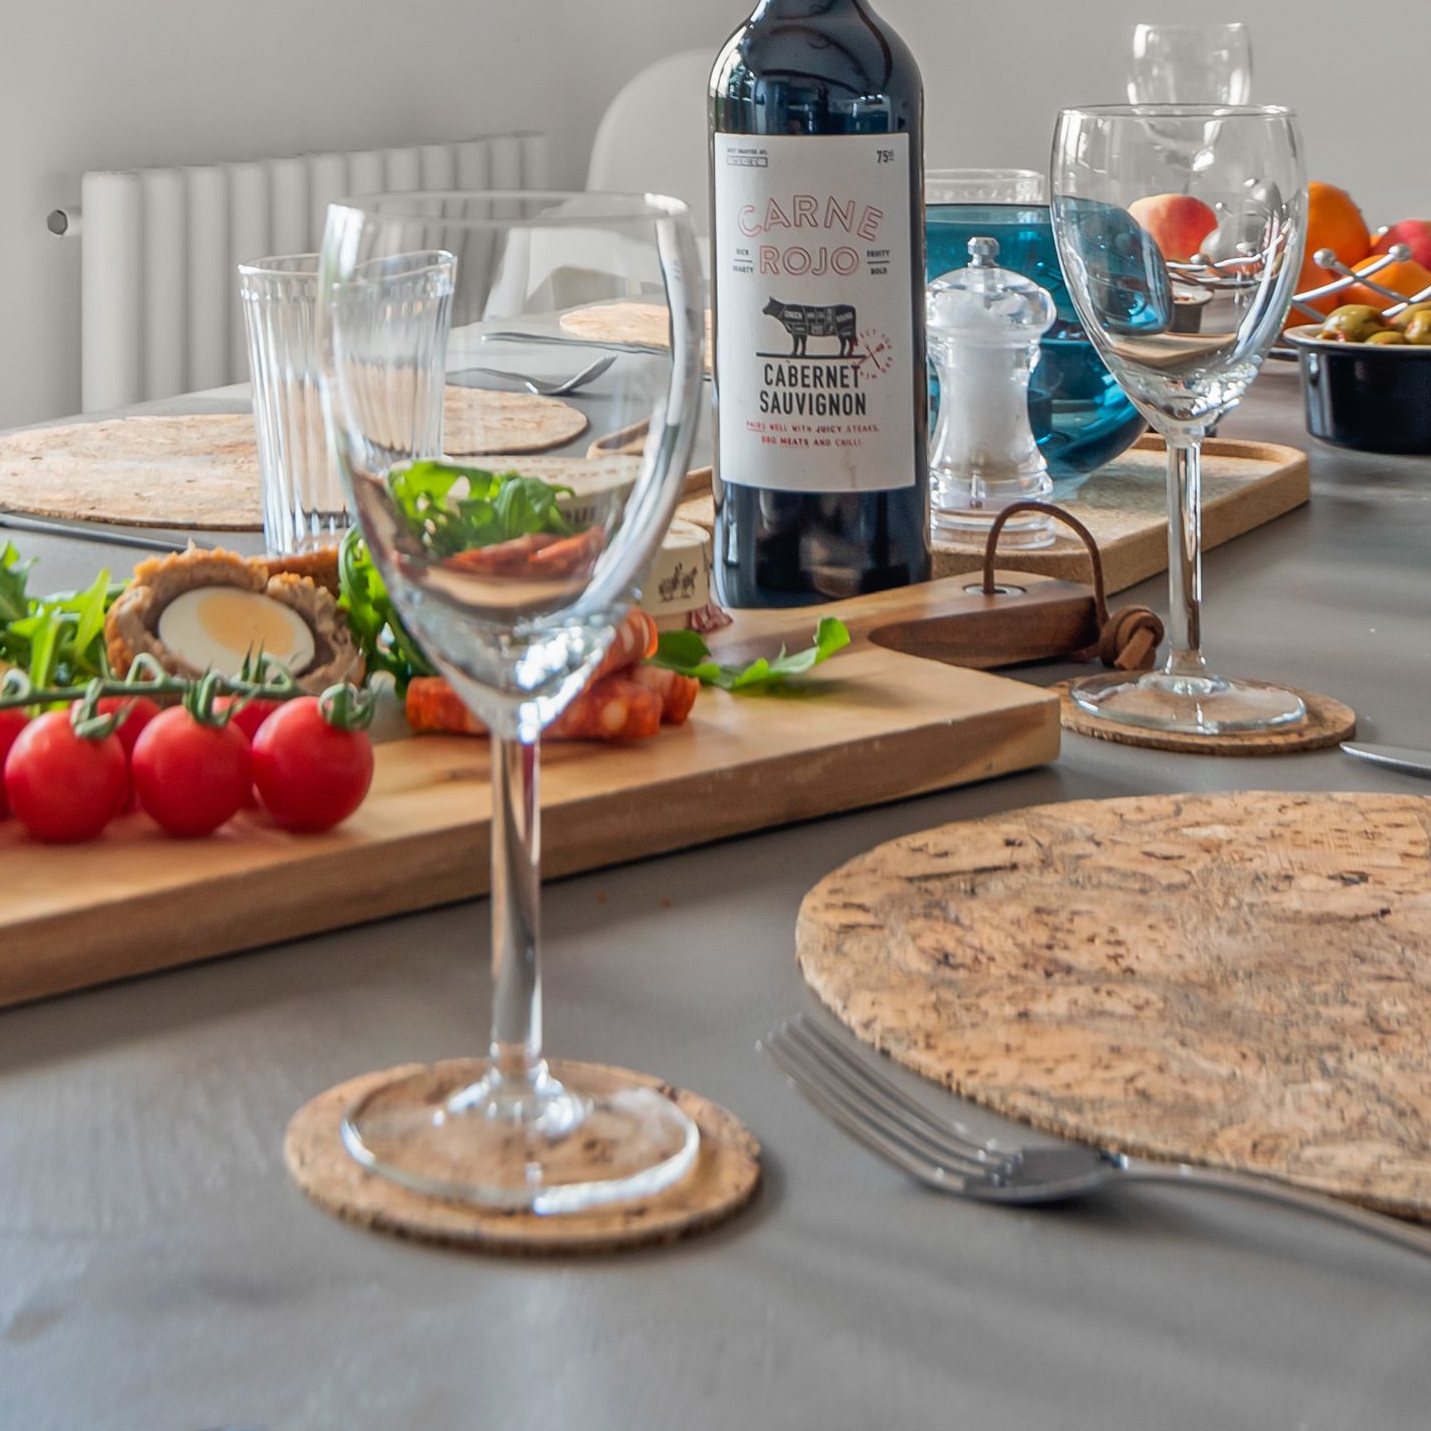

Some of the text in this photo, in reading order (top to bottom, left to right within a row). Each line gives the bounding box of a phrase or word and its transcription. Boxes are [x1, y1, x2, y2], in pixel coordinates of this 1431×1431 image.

[737, 194, 884, 242] CARNE
[759, 245, 860, 276] ROJO
[866, 249, 890, 258] FRUITY
[764, 363, 861, 389] CABERNET
[759, 390, 867, 416] SAUVIGNON
[769, 423, 788, 432] WELL
[792, 424, 812, 433] WITH
[816, 425, 842, 434] JUICY
[780, 436, 809, 446] MEATS
[813, 438, 831, 447] AND
